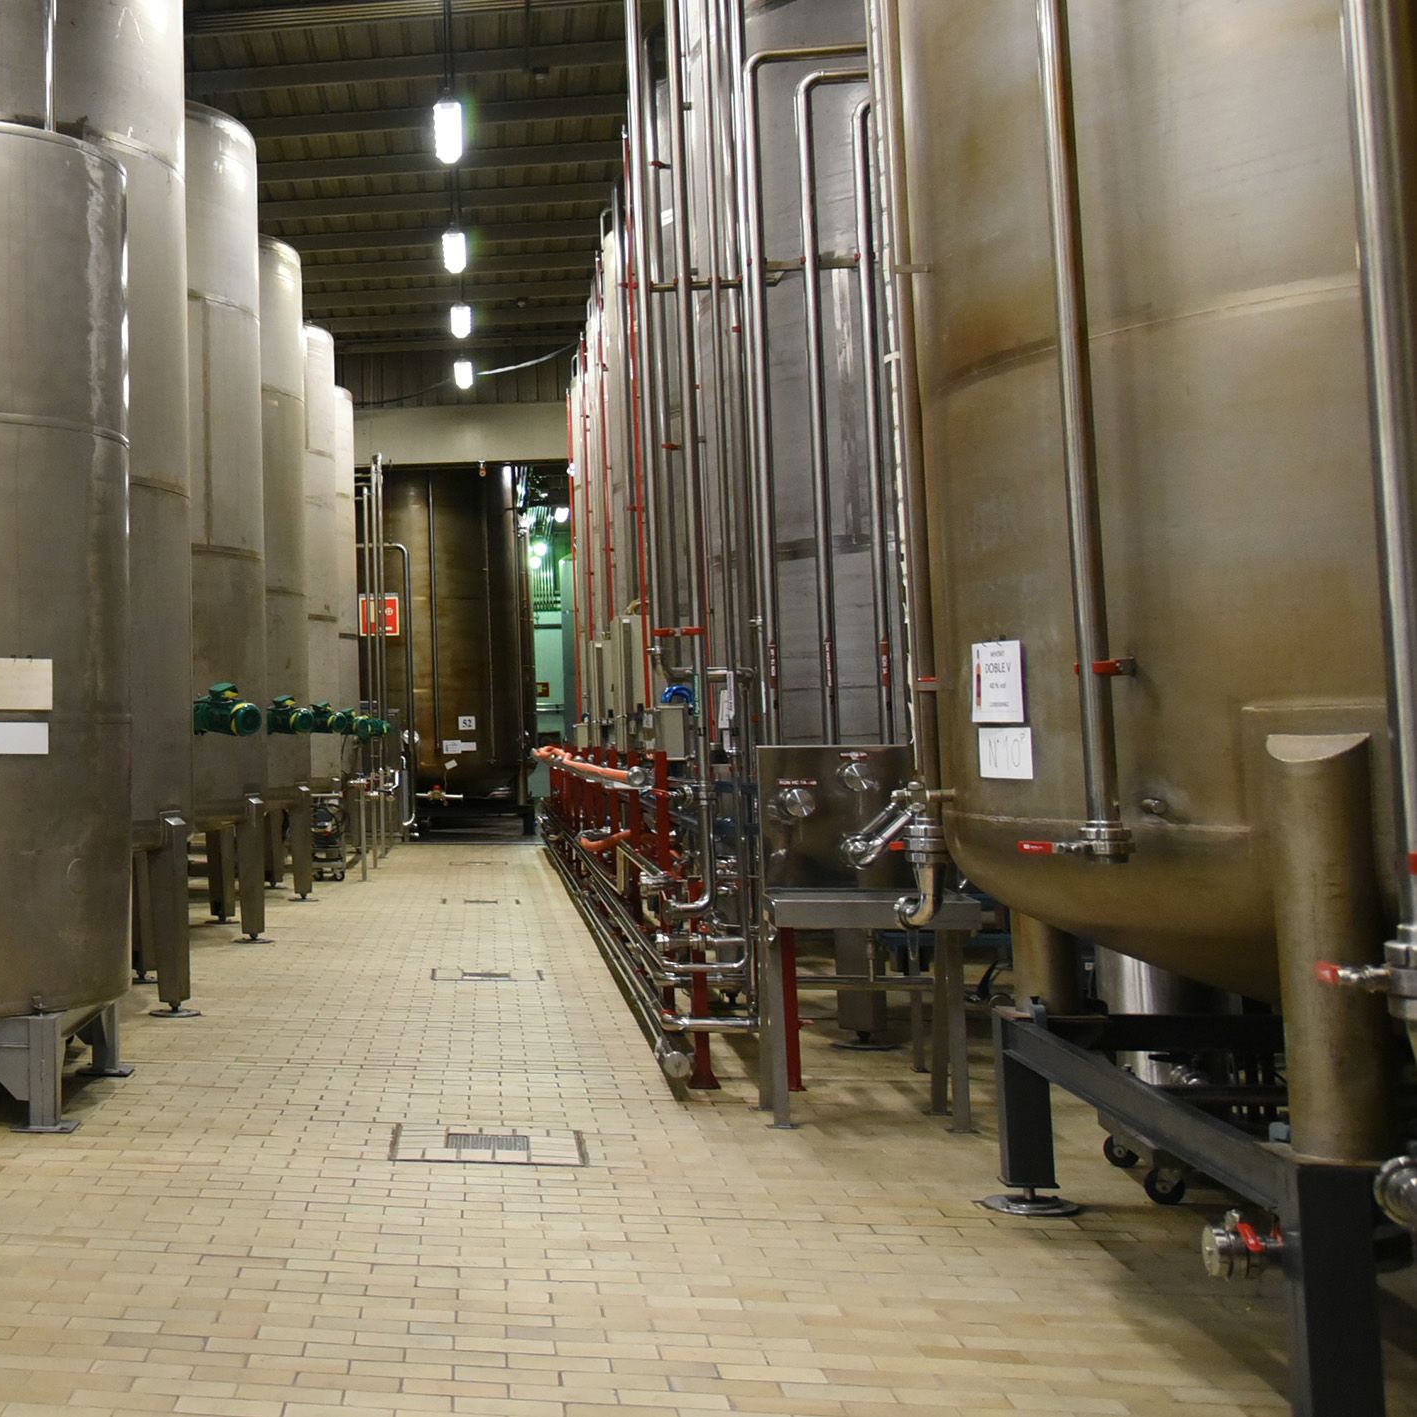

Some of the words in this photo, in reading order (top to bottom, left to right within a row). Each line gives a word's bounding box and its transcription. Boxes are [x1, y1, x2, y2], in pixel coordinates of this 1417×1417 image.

[985, 663, 1006, 674] DOBLE
[1006, 662, 1011, 673] V
[462, 719, 472, 729] 52
